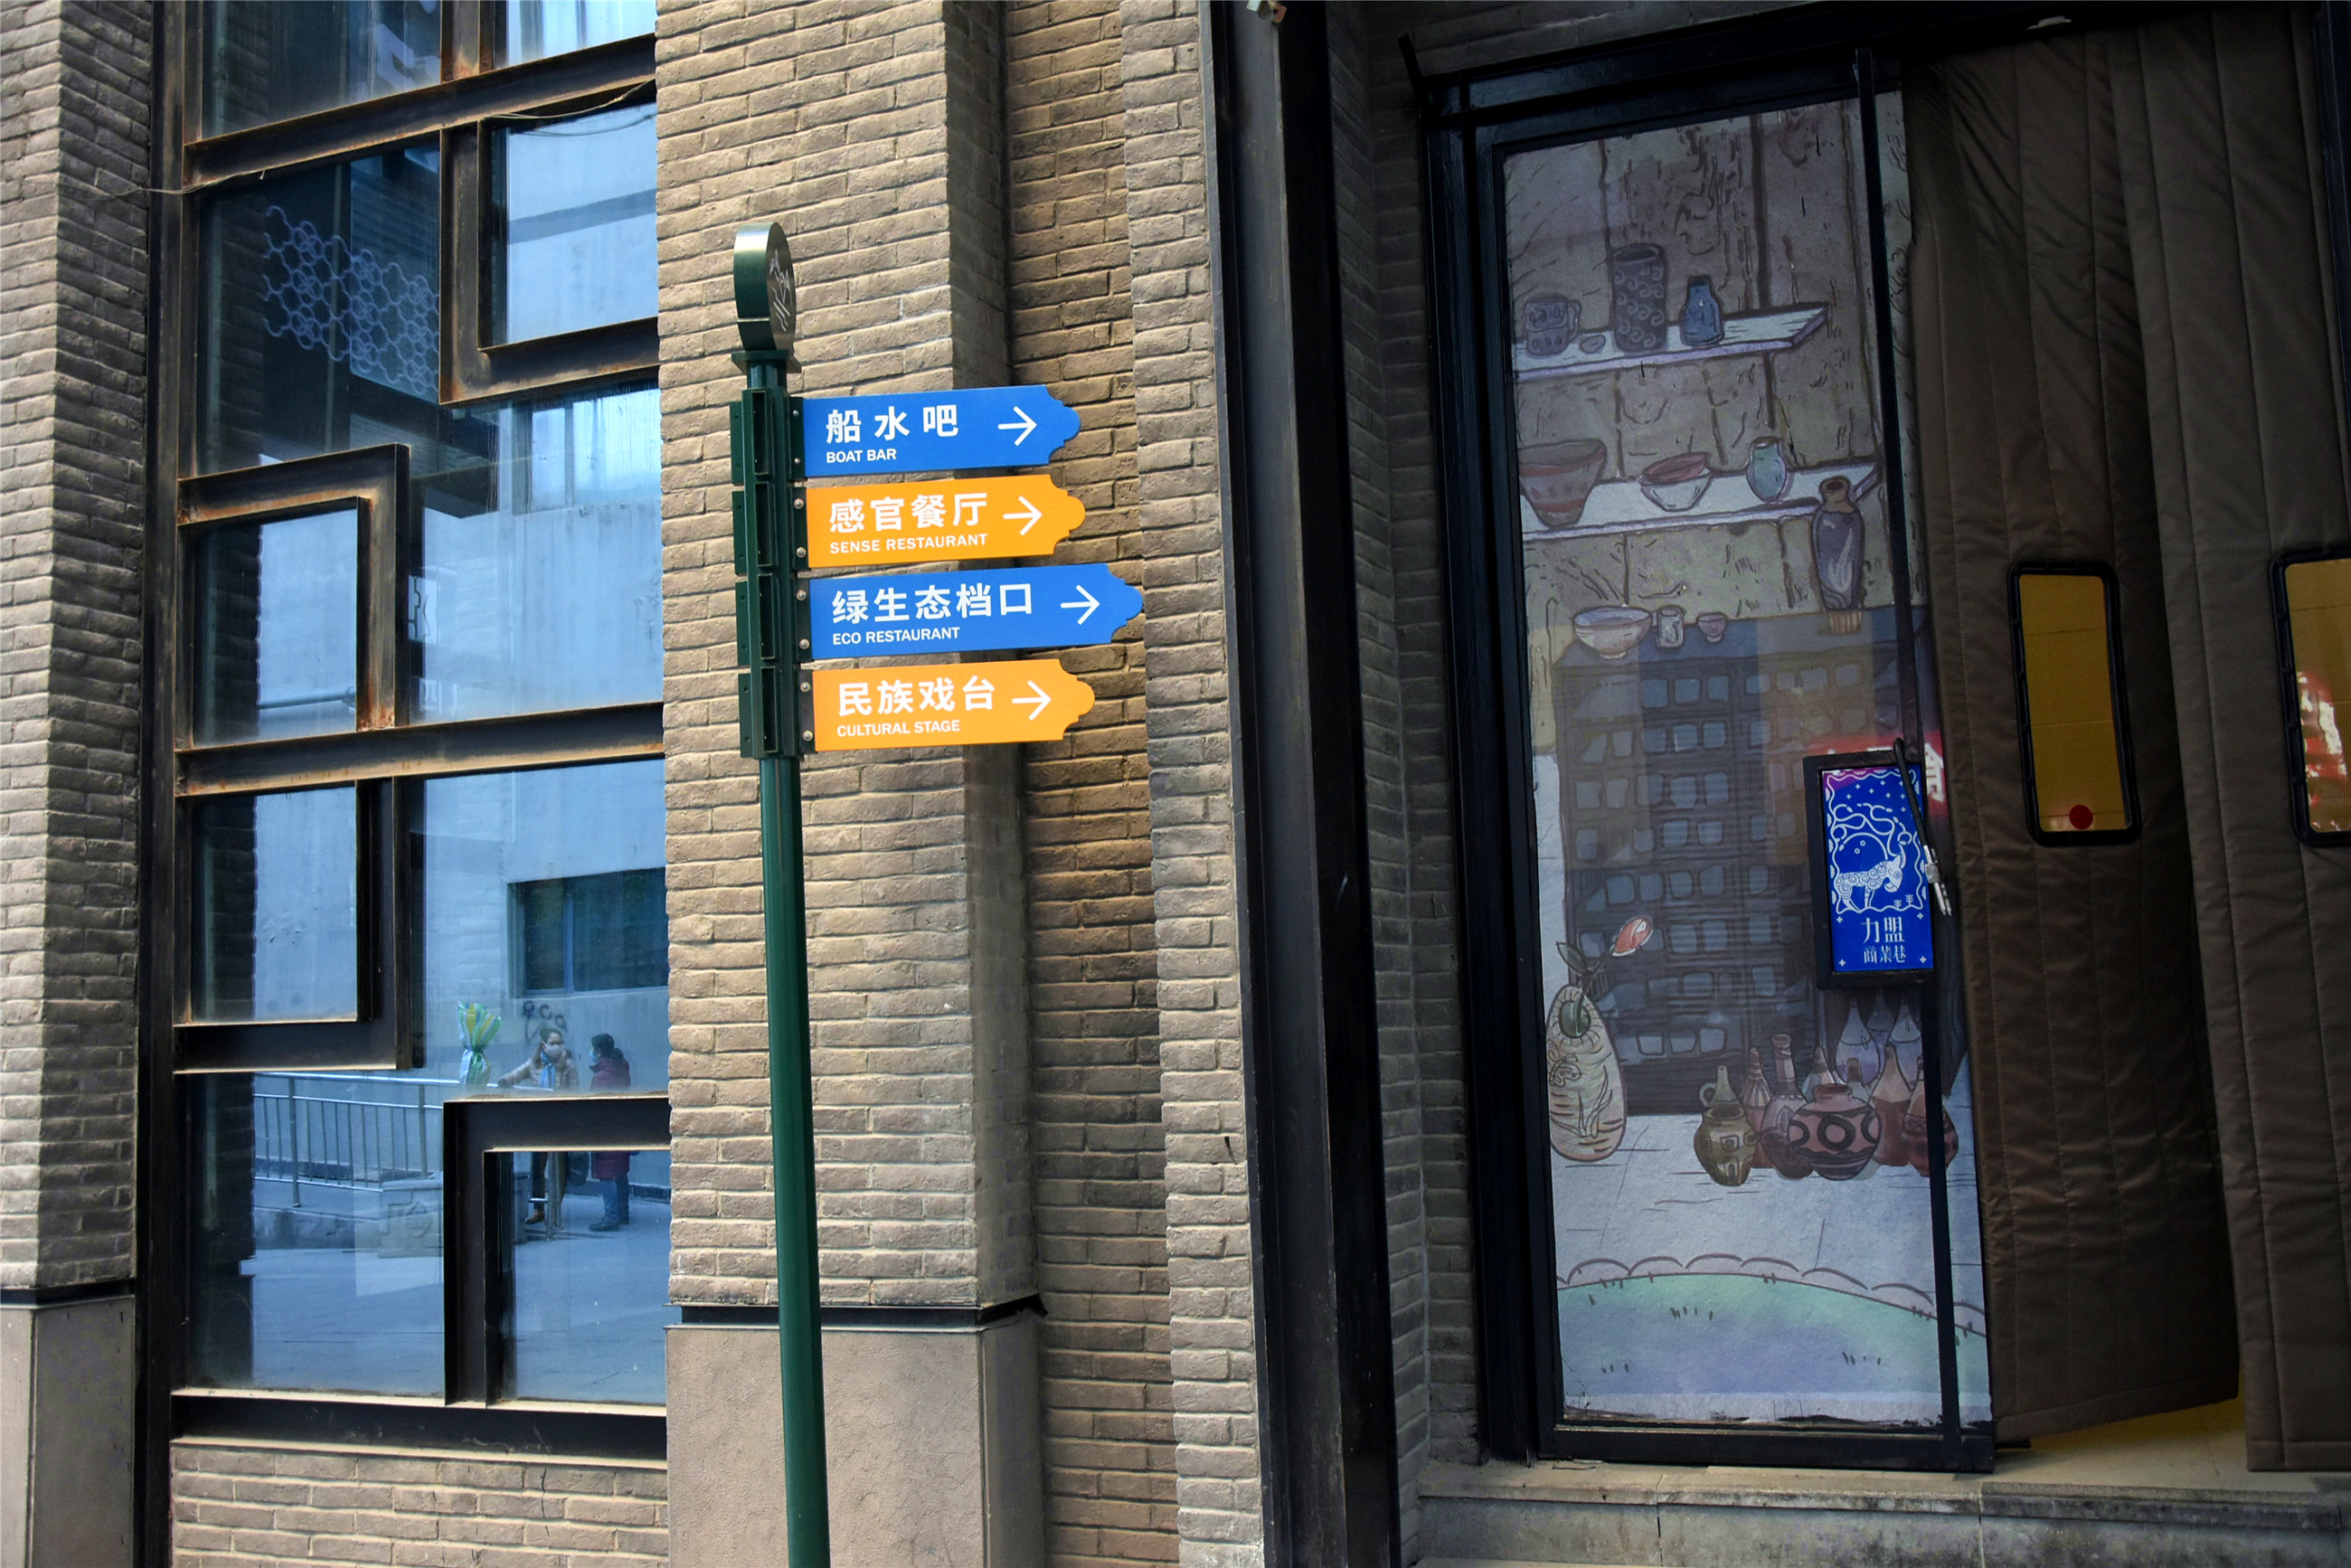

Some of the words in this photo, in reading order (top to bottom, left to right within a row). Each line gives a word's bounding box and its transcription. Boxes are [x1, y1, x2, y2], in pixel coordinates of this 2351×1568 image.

[826, 404, 958, 443] 船水吧
[826, 449, 863, 463] BOAT
[866, 448, 897, 461] BAR
[829, 492, 987, 534] 感官餐厅
[830, 540, 881, 554] SENSE
[885, 534, 988, 551] RESTAURANT
[832, 583, 1033, 625] 绿生态档口
[832, 631, 862, 646] ECO
[865, 627, 960, 644] RESTAURANT
[838, 675, 996, 717] 民族戏台
[836, 722, 911, 737] CULTURAL
[913, 720, 961, 733] STAGE
[1860, 916, 1905, 943] 力盟
